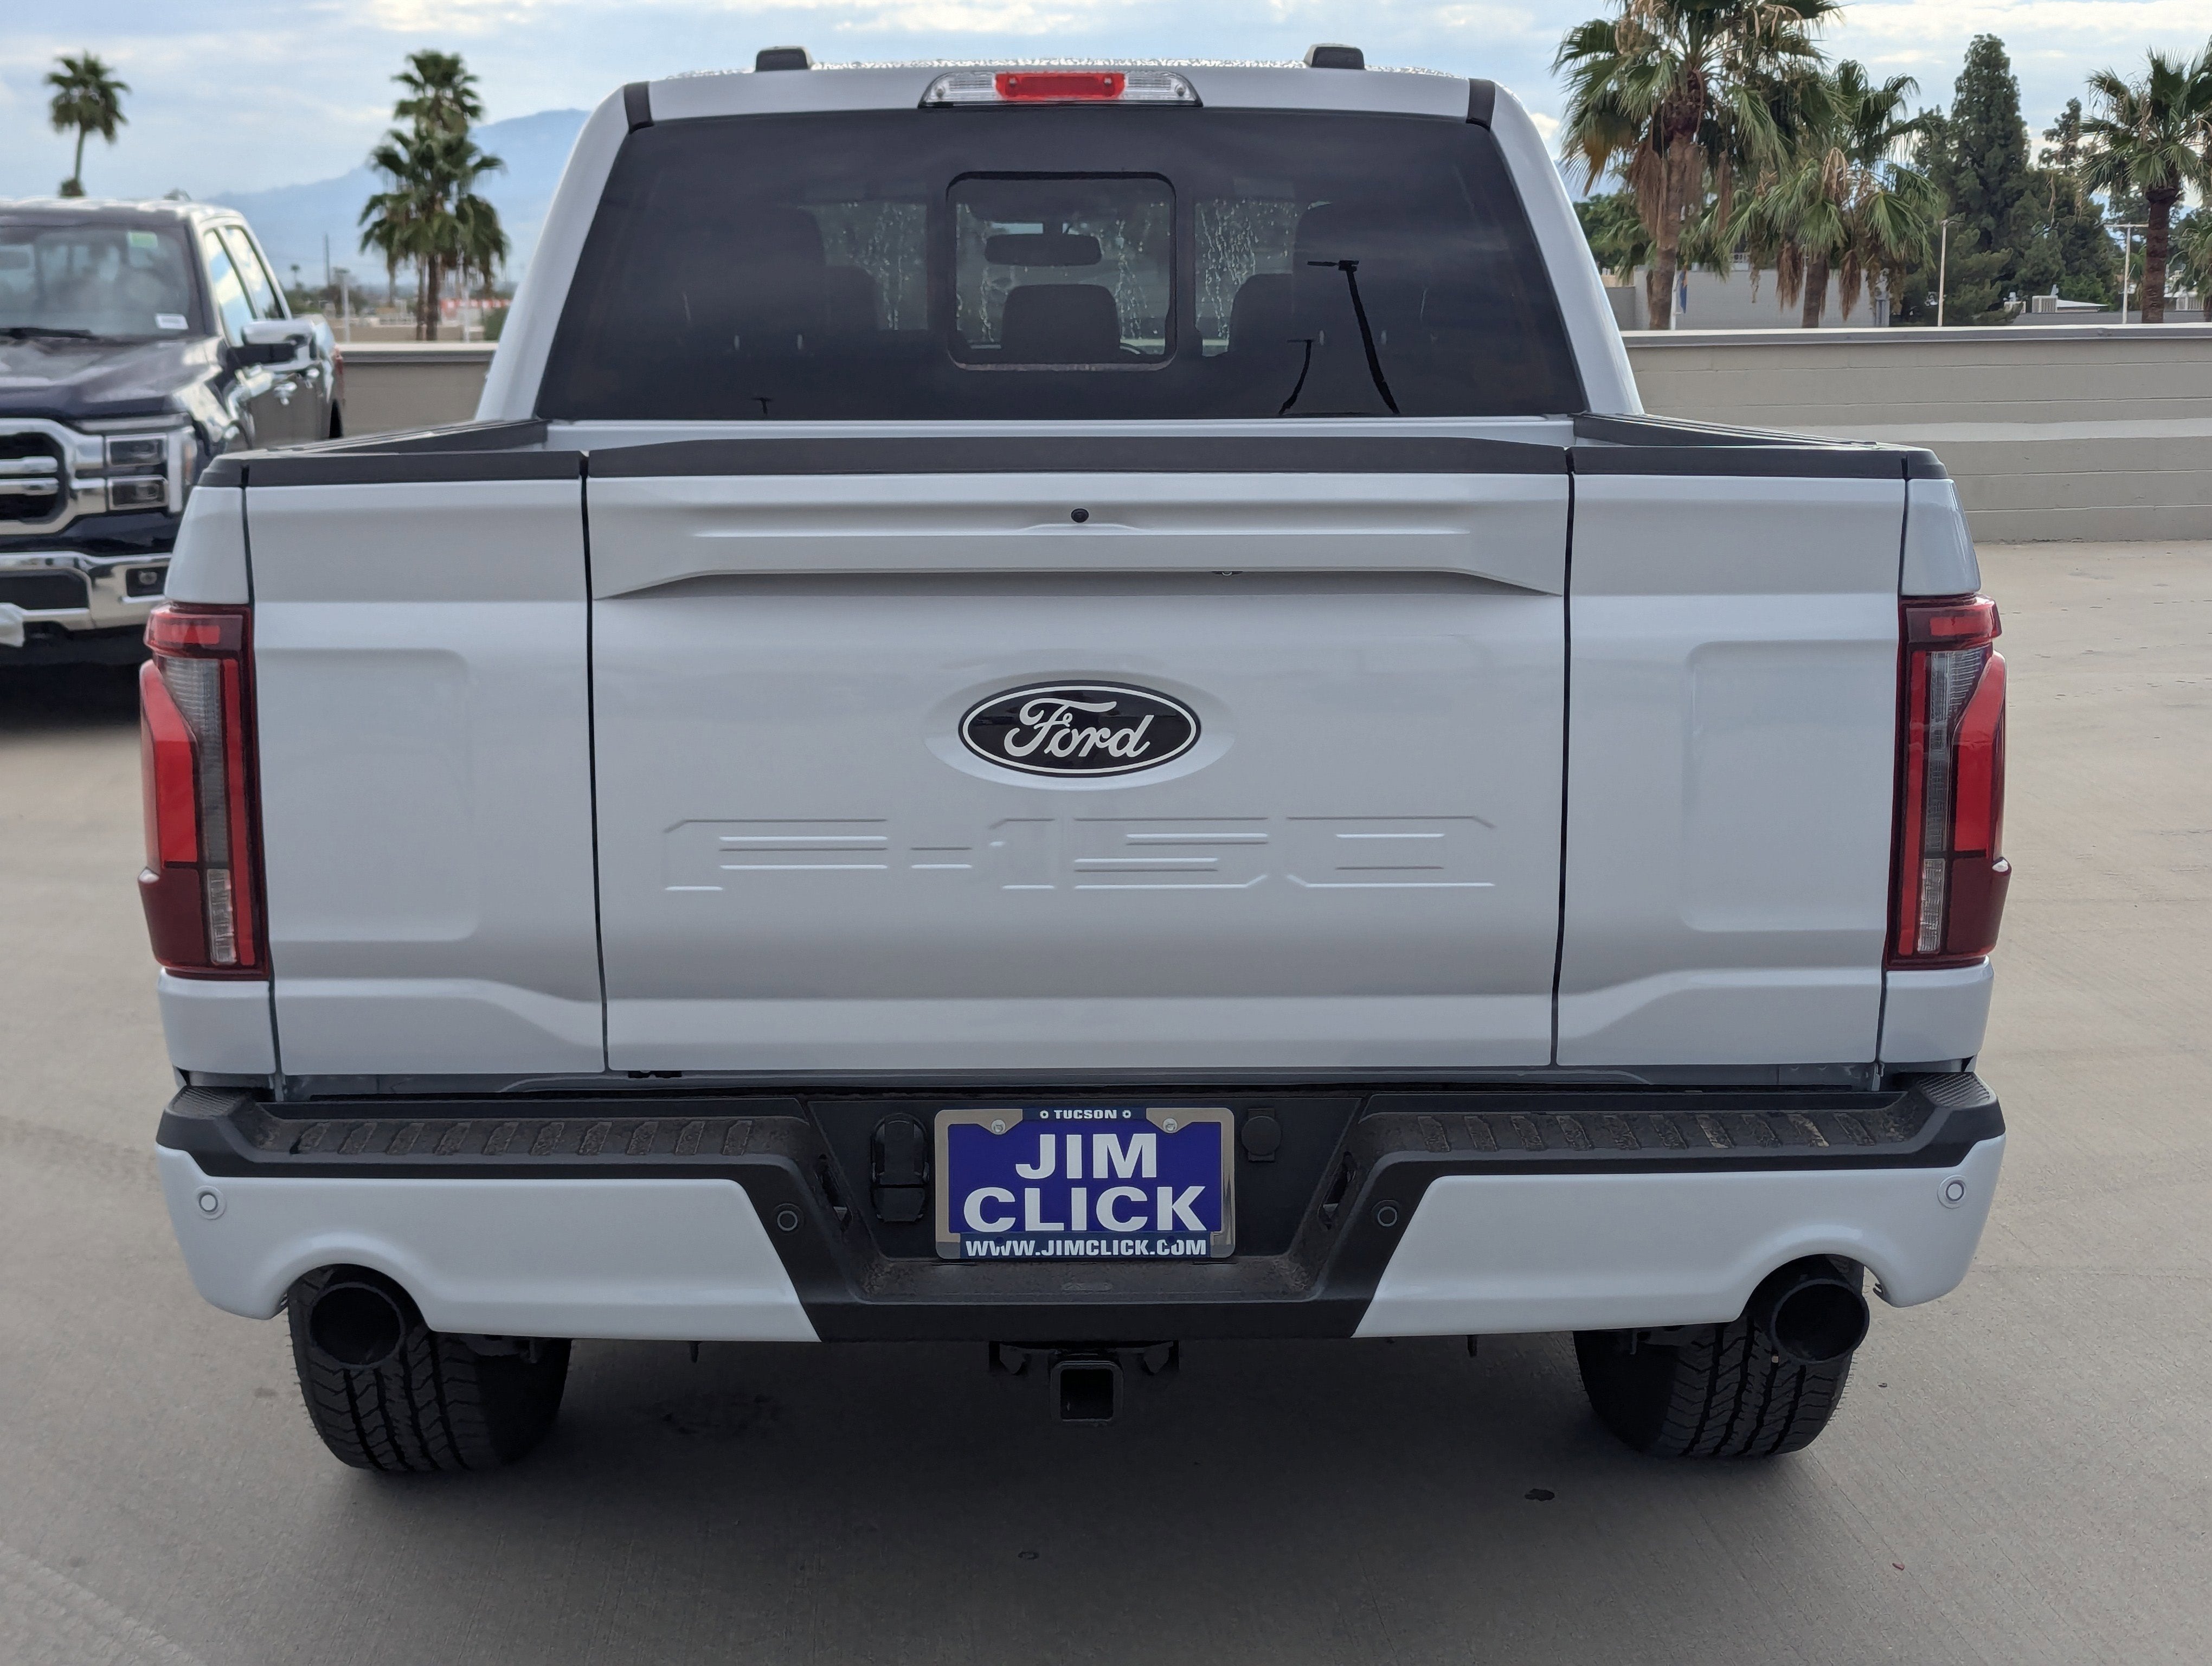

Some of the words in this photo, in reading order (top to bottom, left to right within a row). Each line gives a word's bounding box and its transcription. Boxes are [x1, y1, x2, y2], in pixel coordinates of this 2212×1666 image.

[1004, 697, 1154, 758] Ford
[663, 815, 1495, 890] F-150
[1054, 1109, 1117, 1119] TUCSON
[1015, 1133, 1156, 1179] JIM
[963, 1186, 1207, 1232] CLICK
[965, 1239, 1206, 1257] WWW.JIMCLICK.COM
